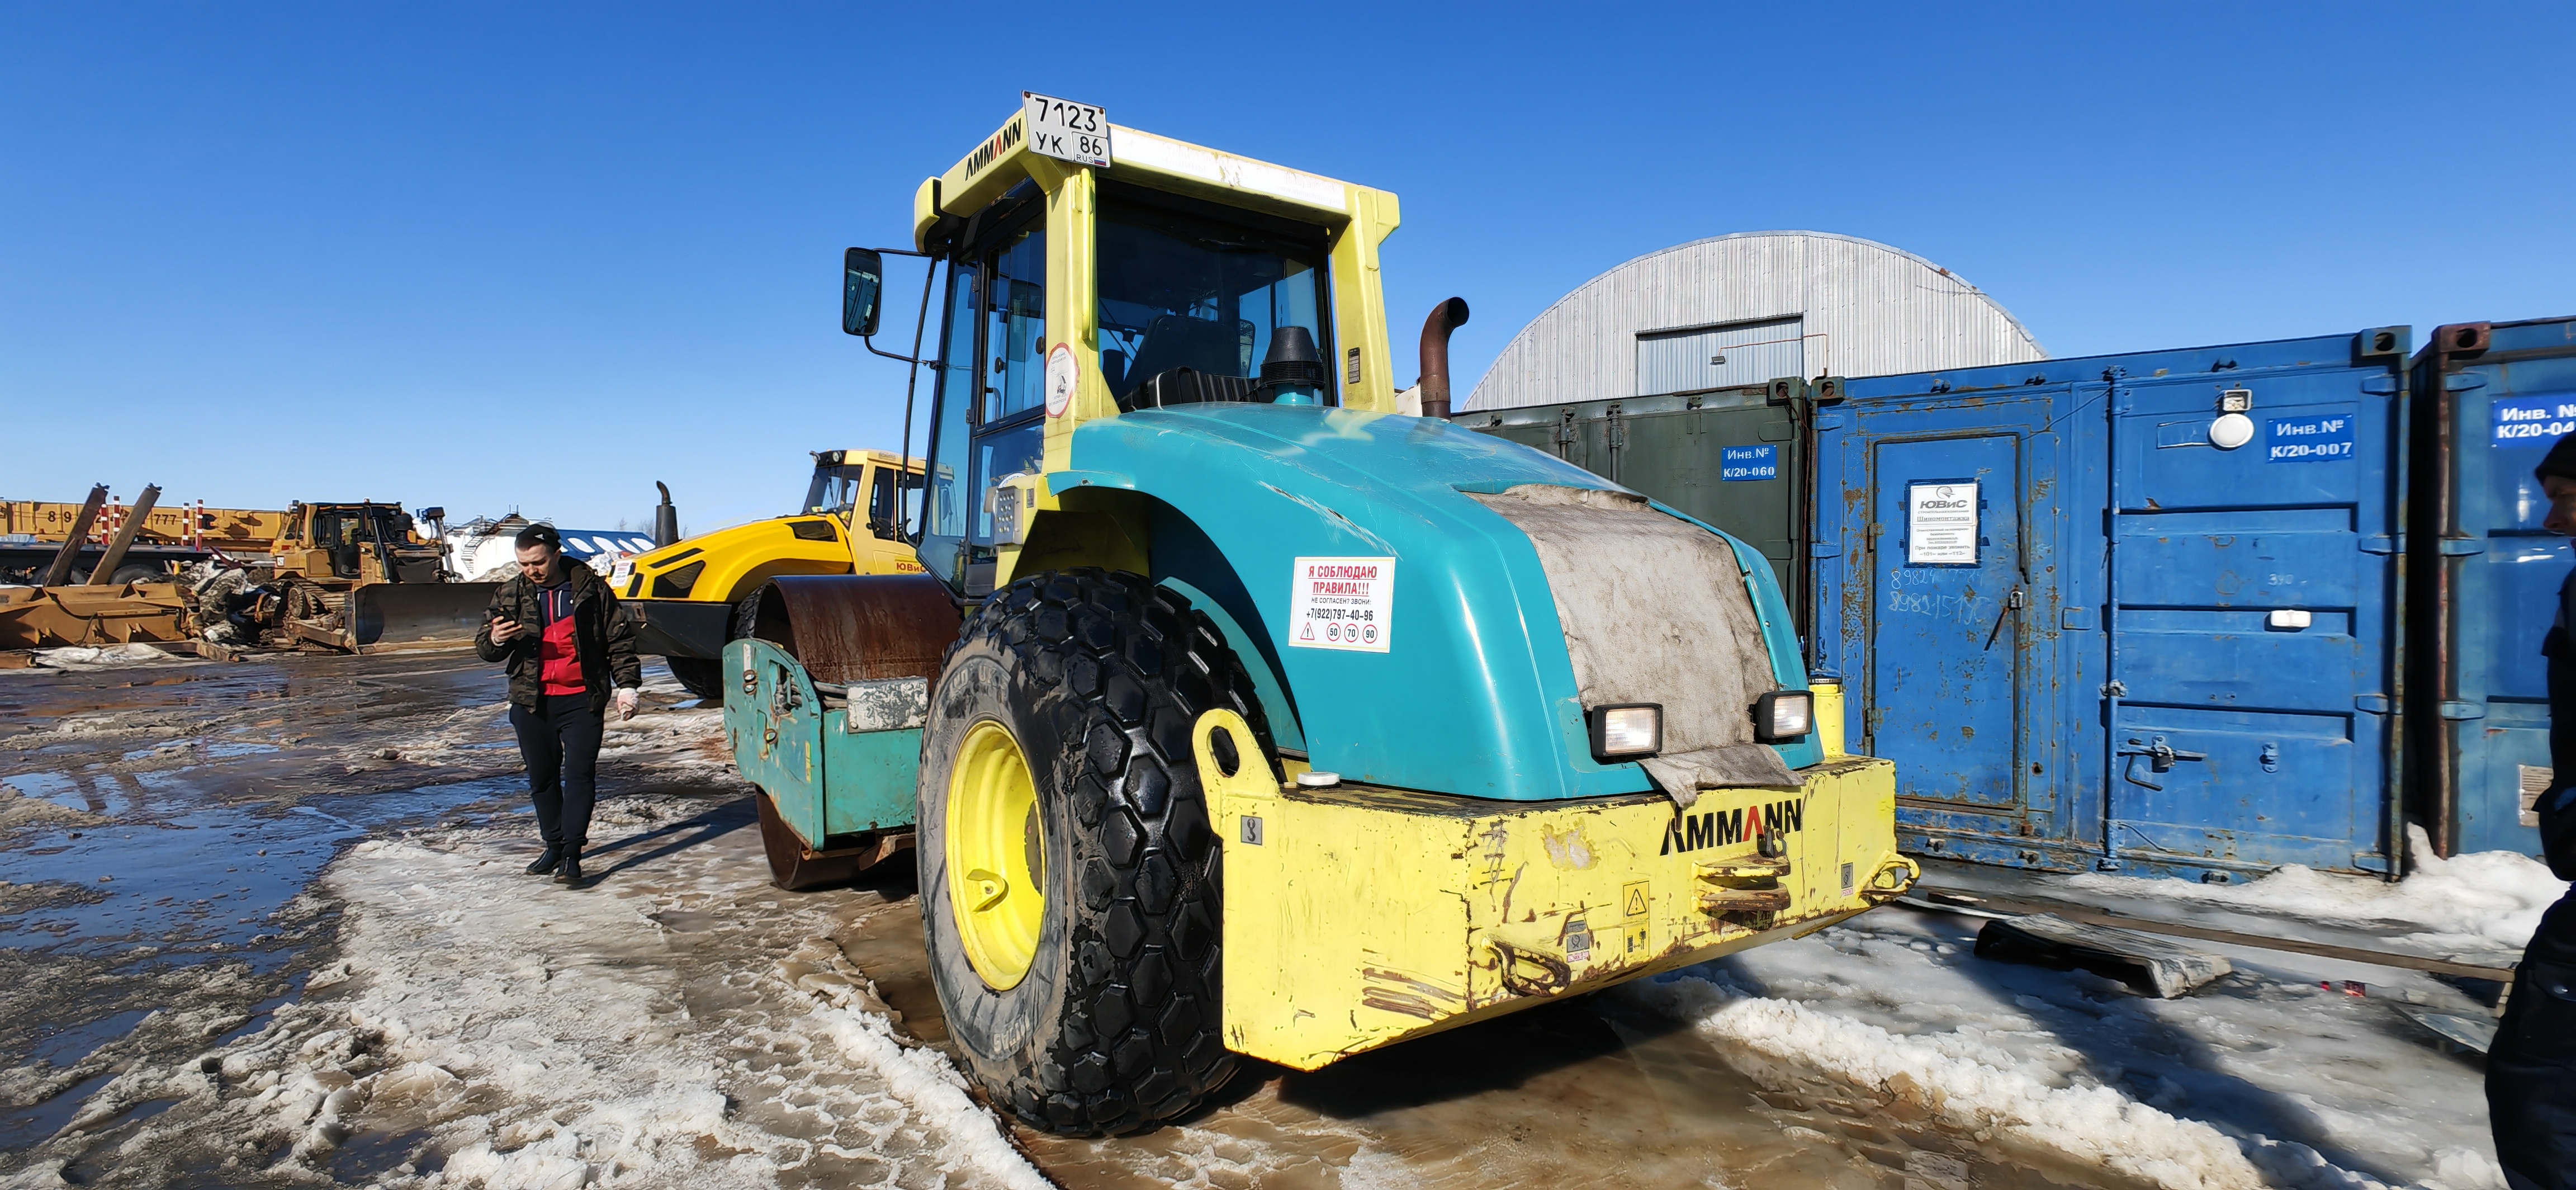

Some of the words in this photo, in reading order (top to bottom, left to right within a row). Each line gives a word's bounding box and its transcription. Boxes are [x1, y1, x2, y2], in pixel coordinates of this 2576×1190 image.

[1035, 97, 1096, 132] 7123
[965, 117, 1022, 181] AMMANN
[1079, 136, 1102, 156] 86
[1076, 154, 1093, 163] RUS
[2501, 408, 2551, 421] Инв.
[2271, 442, 2352, 459] К/20-007
[1723, 466, 1775, 478] К/20-060
[1920, 499, 1968, 509] ЮВиС
[154, 513, 177, 525] 777
[1308, 565, 1315, 577] Я
[1318, 565, 1377, 579] СОБЛЮДАЮ
[1313, 582, 1369, 595] ПРАВИЛА!!!
[1306, 608, 1374, 621] +7(922)797-40-96
[1329, 628, 1338, 636] 50
[1366, 630, 1375, 639] 90
[1660, 798, 1801, 856] AMMANN
